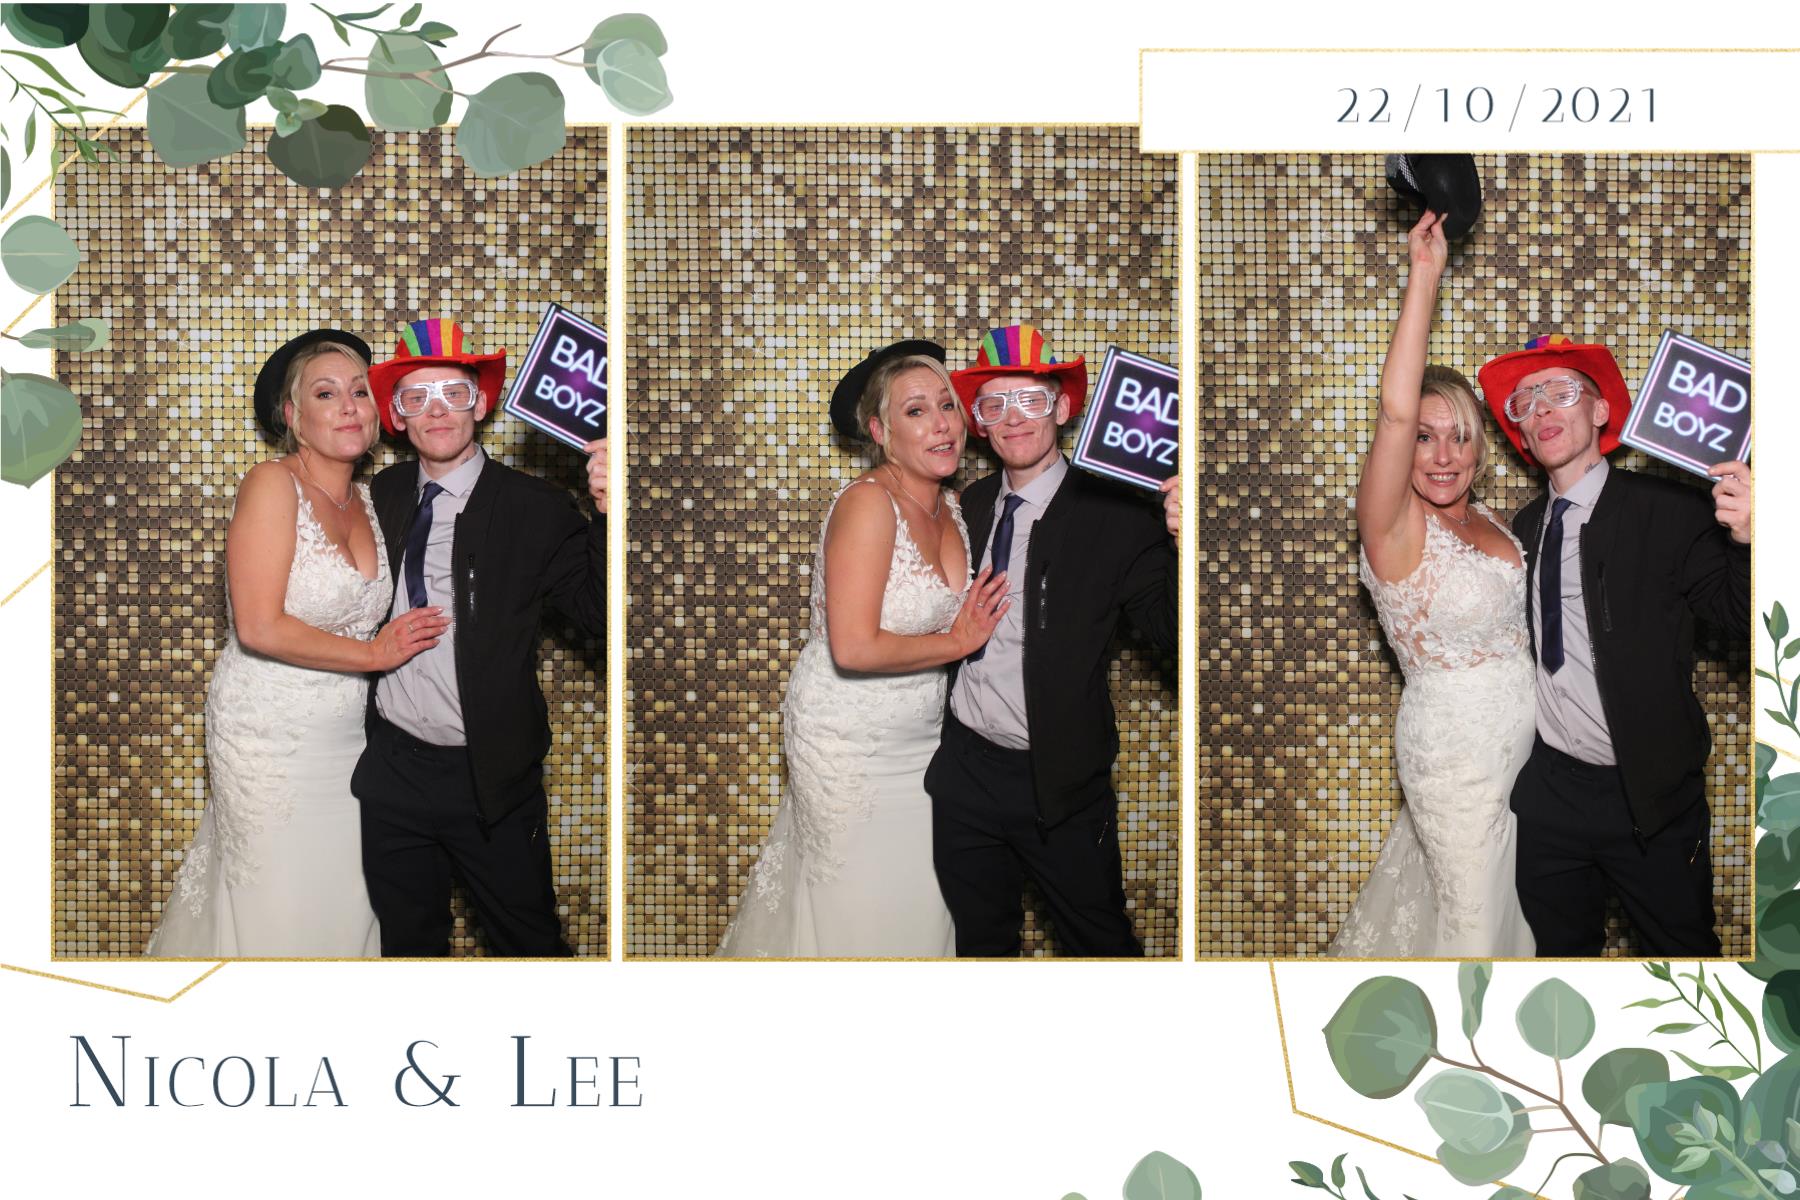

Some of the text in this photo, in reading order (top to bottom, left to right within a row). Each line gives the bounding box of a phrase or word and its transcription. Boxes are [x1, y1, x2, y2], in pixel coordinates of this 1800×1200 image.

[535, 374, 606, 428] BOYZ
[1115, 376, 1179, 426] BAD
[1667, 359, 1748, 414] BAD
[1103, 420, 1179, 466] BOYZ
[1653, 401, 1734, 453] BOYZ
